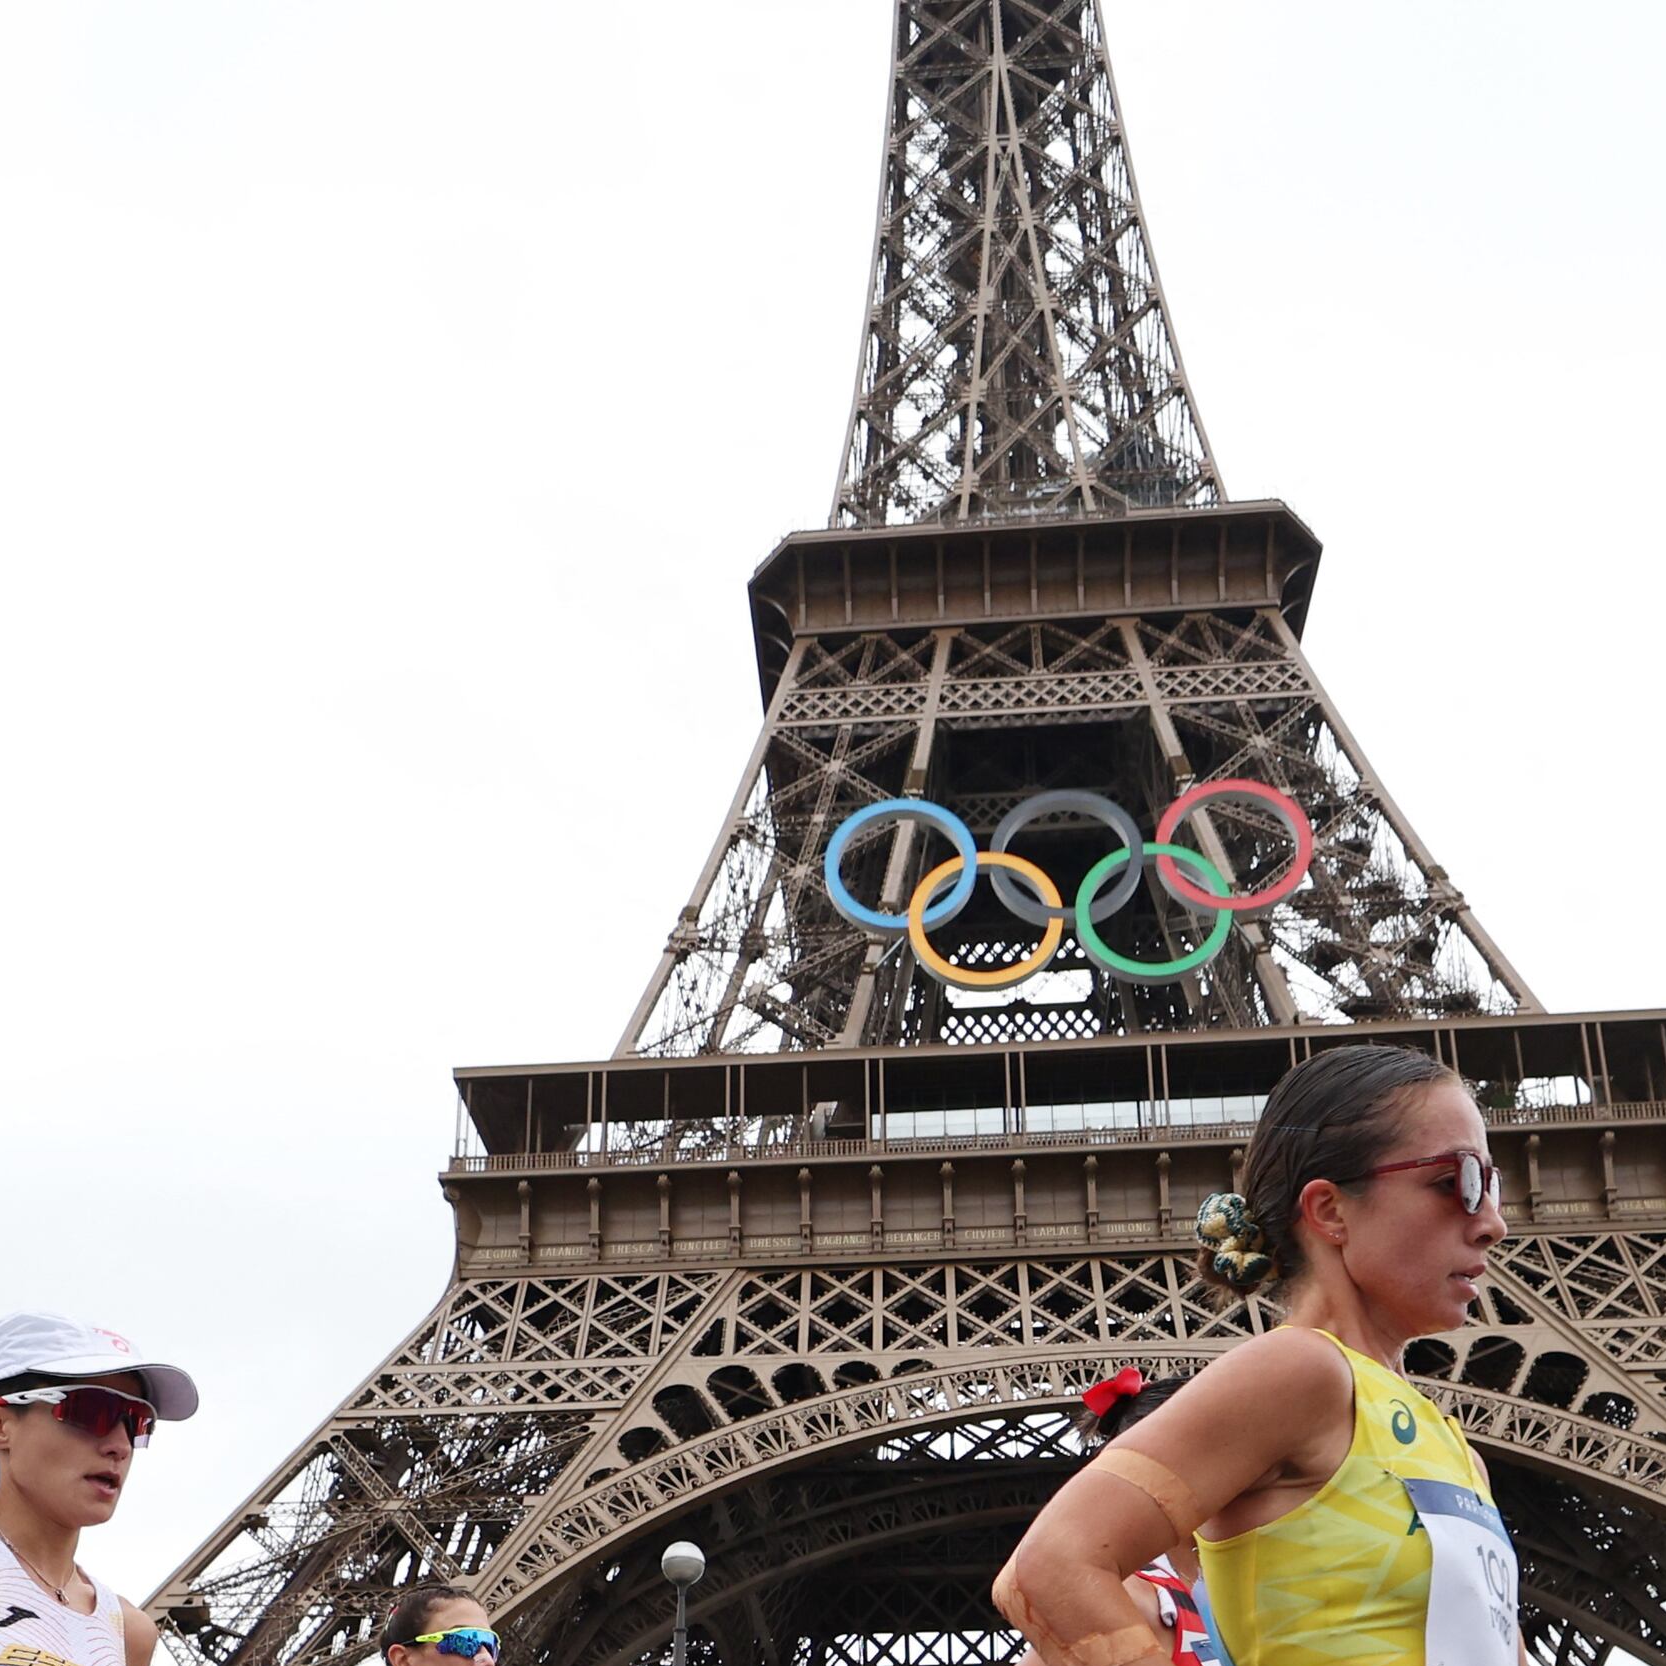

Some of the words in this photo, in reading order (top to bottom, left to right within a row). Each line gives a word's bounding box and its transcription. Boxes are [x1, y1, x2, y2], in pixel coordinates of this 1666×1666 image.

[1033, 1225, 1079, 1236] LAPLACE
[1106, 1222, 1151, 1233] DULONG
[816, 1234, 869, 1245] LAGRANGE
[885, 1231, 941, 1242] BELANGER
[964, 1229, 1006, 1239] CUVIER
[611, 1242, 655, 1254] TRESCA
[749, 1237, 794, 1248] BRESSE
[539, 1246, 584, 1257] LALANDE
